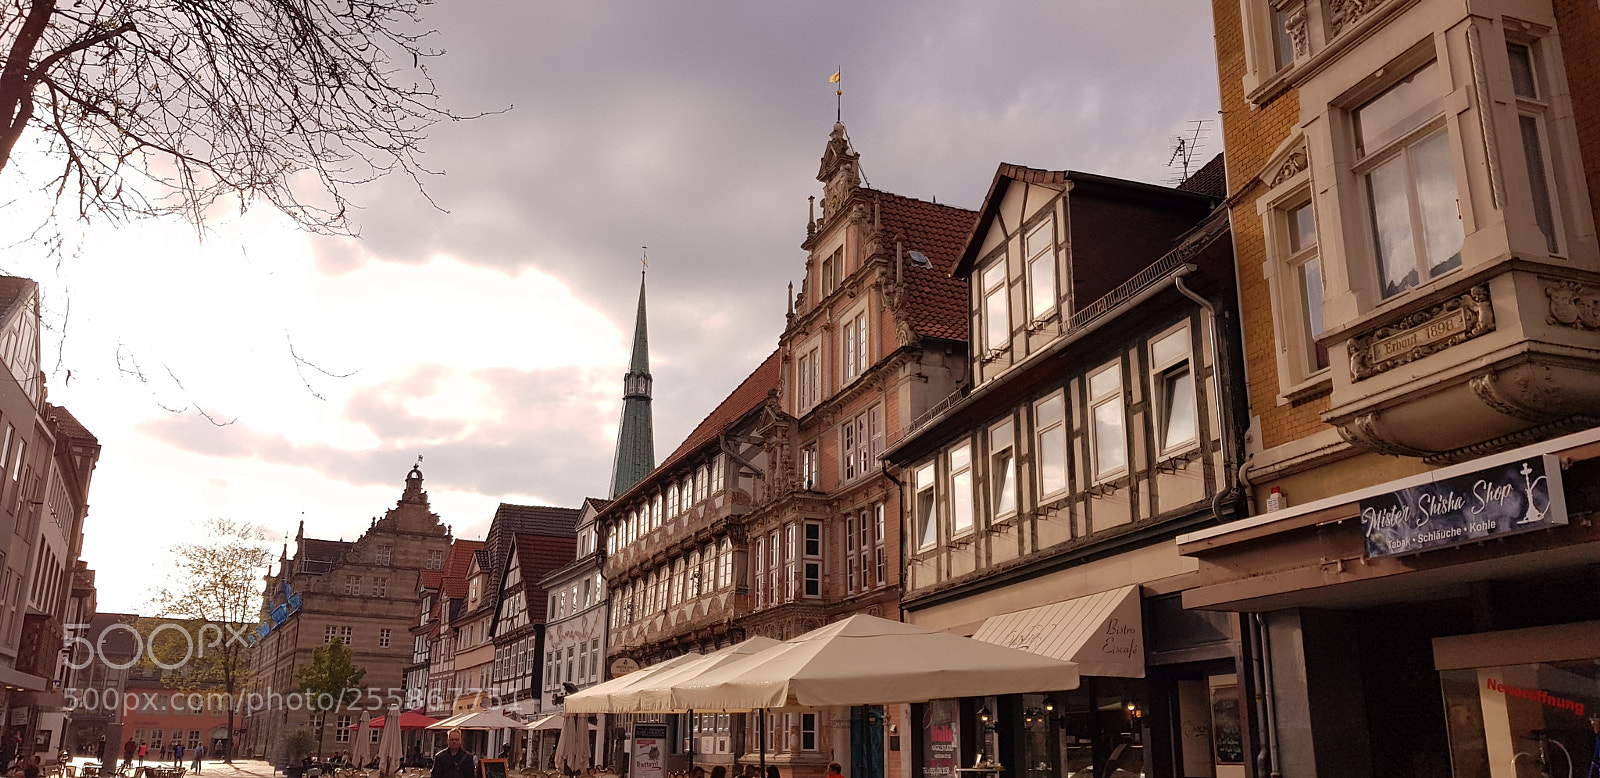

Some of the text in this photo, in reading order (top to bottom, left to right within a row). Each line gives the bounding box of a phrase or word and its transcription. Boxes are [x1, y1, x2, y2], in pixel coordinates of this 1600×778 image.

[1384, 319, 1454, 355] Erbaut 1898
[1361, 479, 1514, 538] Mister Shisha Shop
[1387, 519, 1497, 551] Tabak Schläuche Kohle
[1106, 618, 1136, 635] Bistro
